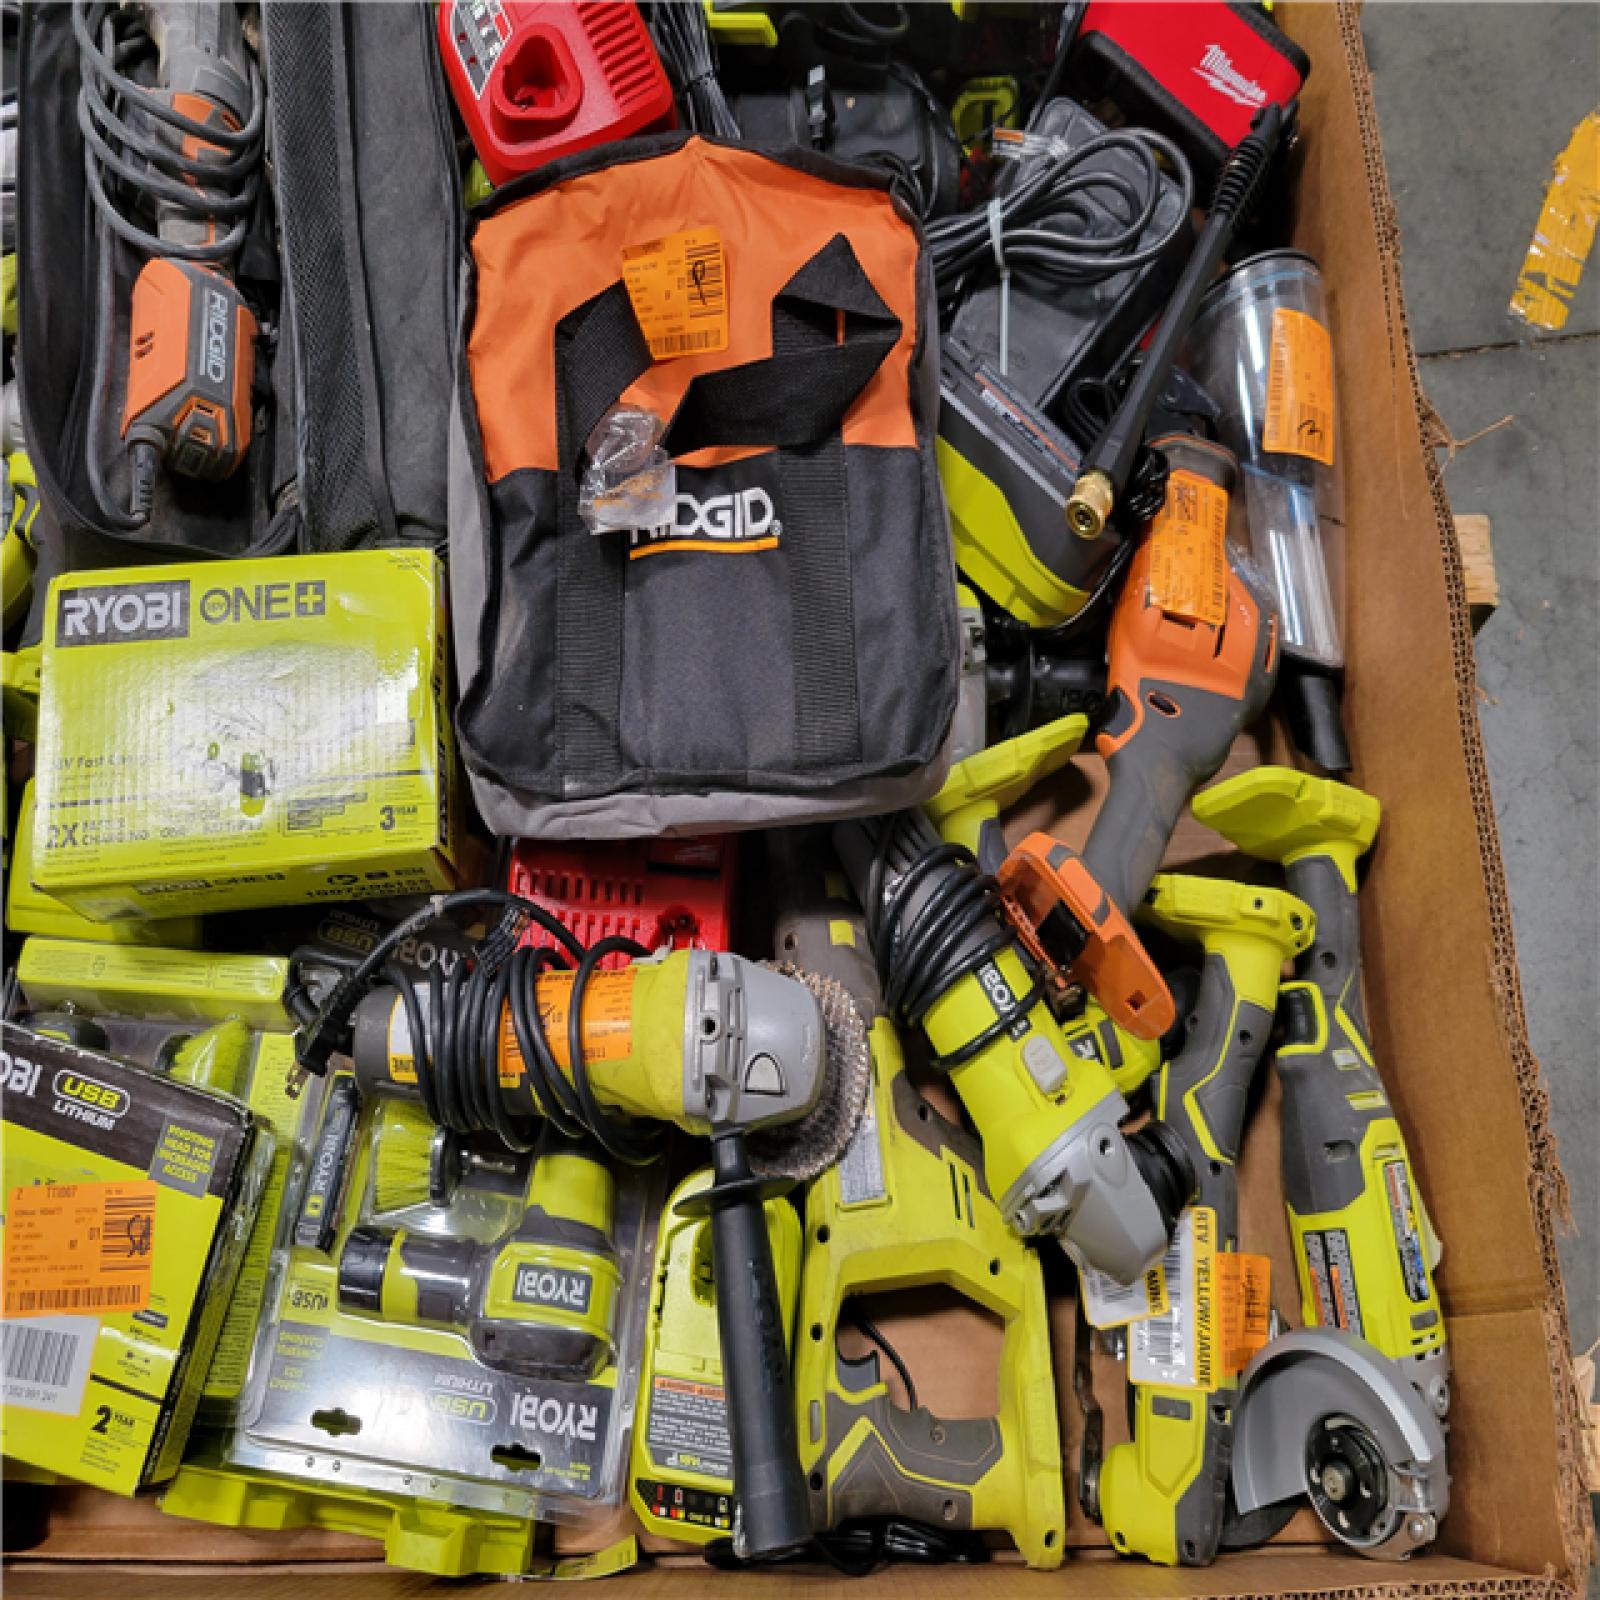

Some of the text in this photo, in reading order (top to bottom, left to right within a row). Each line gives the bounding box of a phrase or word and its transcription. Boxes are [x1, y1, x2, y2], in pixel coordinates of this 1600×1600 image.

[209, 290, 226, 383] RIDGID
[629, 487, 774, 544] DGID
[64, 592, 182, 638] RYOBI
[380, 805, 396, 830] 3
[46, 823, 79, 849] 2X
[63, 1075, 121, 1109] USB
[516, 1270, 584, 1305] RYOBI
[91, 1404, 112, 1433] 2
[509, 1391, 599, 1441] RYOBI
